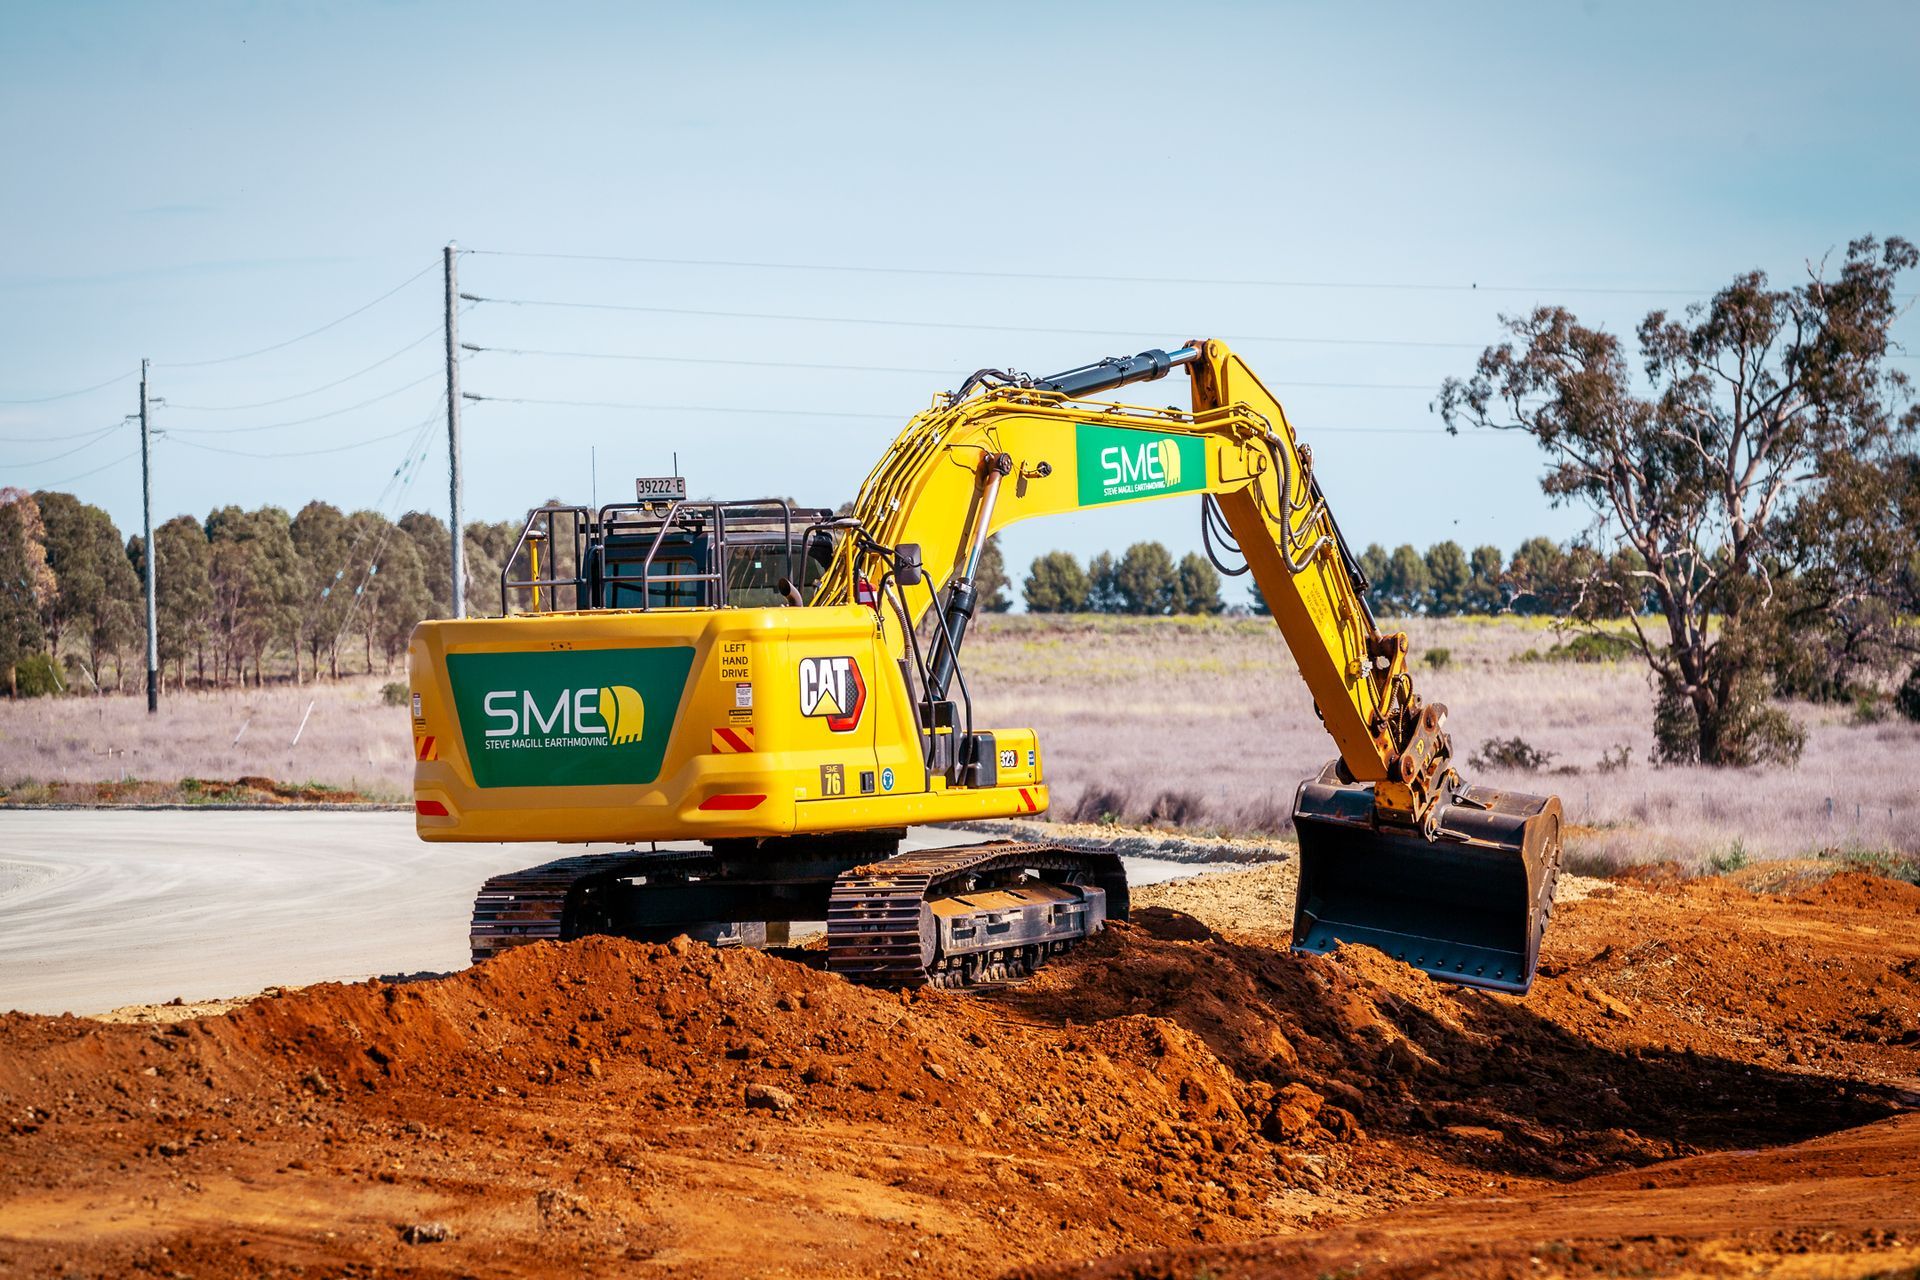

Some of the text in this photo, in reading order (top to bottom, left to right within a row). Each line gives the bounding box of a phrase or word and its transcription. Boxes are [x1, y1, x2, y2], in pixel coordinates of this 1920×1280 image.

[1101, 441, 1164, 486] SME
[1103, 480, 1165, 496] STEVE MAGILL EARTHMOVING
[724, 643, 746, 653] LEFT
[722, 656, 748, 665] HAND
[722, 669, 749, 678] DRIVE
[799, 657, 850, 716] CAT
[484, 688, 607, 737] SME
[485, 736, 608, 750] STEVE MAGILL EARTHMOVING
[1000, 750, 1015, 767] 323
[824, 772, 841, 795] 76
